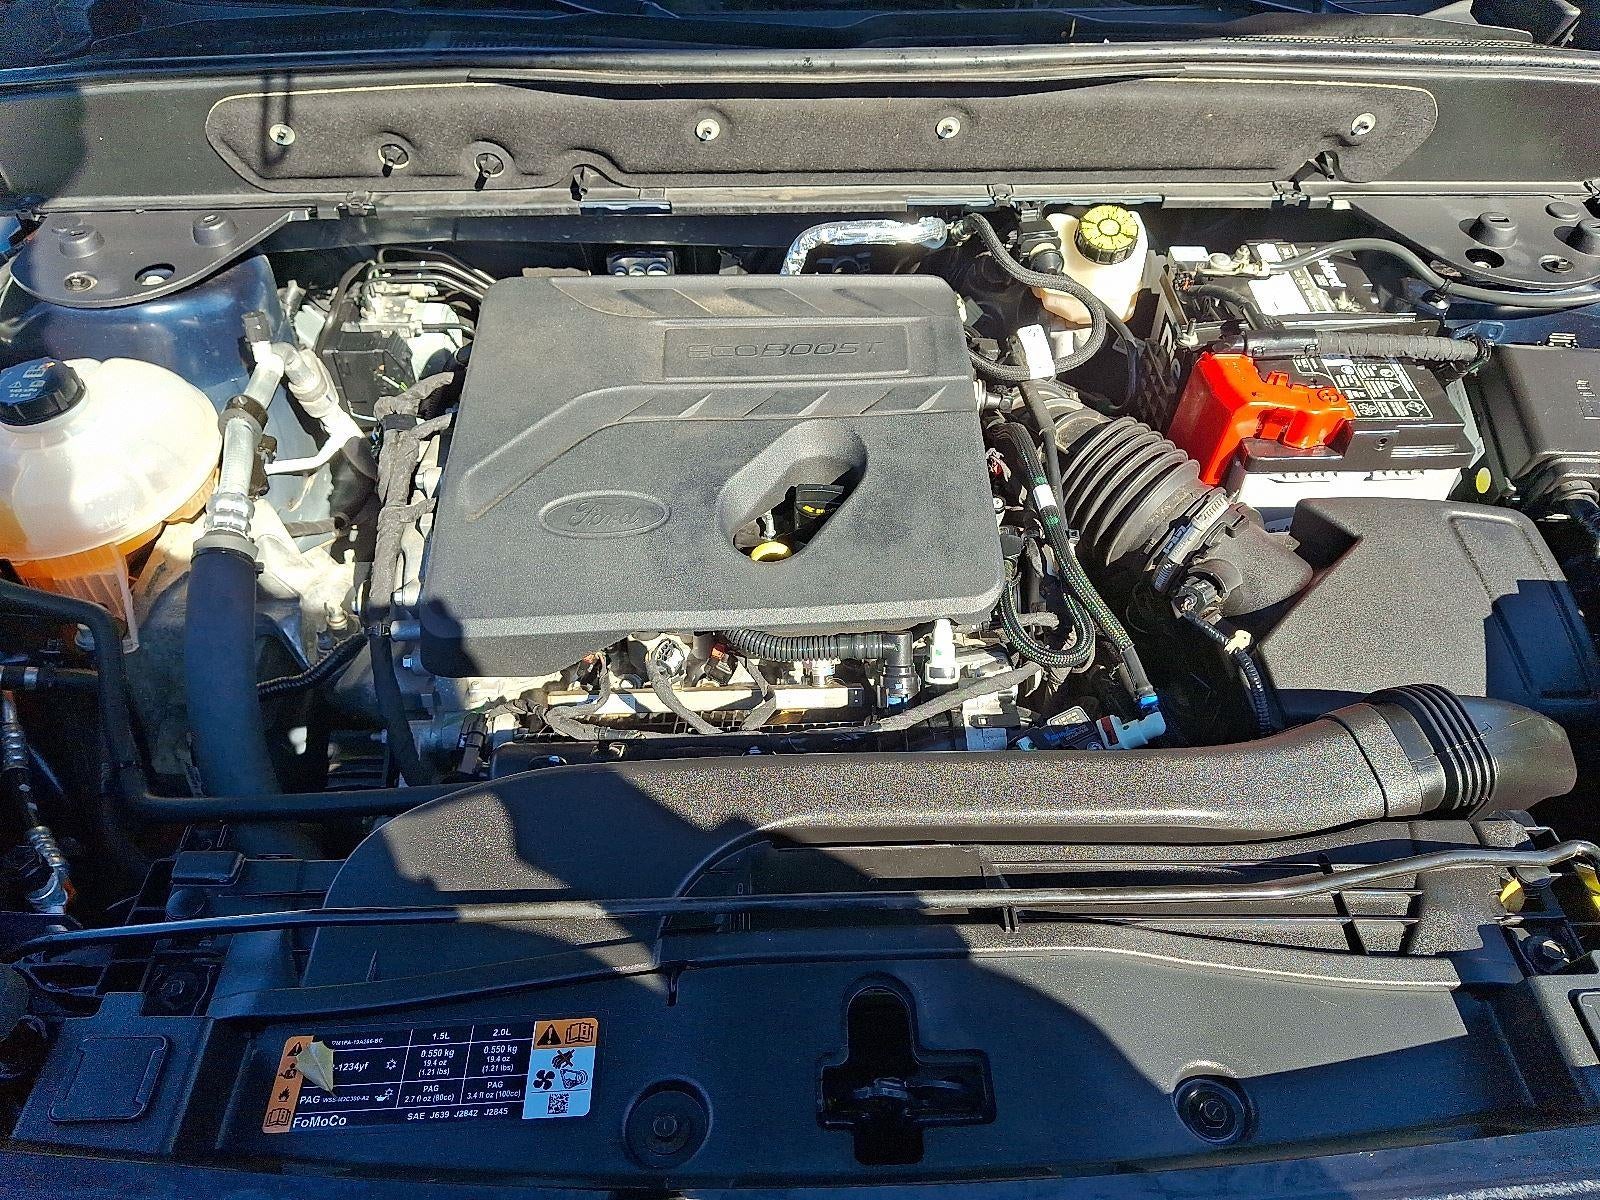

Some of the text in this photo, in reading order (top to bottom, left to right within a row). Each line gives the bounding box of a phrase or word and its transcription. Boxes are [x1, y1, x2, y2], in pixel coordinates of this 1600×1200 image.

[688, 341, 884, 359] ECOBOOST
[568, 501, 641, 527] Ford
[444, 1050, 454, 1058] kg
[507, 1045, 518, 1054] kg
[333, 1062, 369, 1072] -1234yf
[482, 1064, 513, 1073] (1.21 lbs)
[419, 1068, 449, 1077] (1.21 lbs)
[487, 1081, 503, 1089] PAG
[496, 1090, 521, 1099] (100cc)
[300, 1096, 320, 1104] PAG
[484, 1108, 508, 1116] J2845
[293, 1115, 346, 1128] FoMoCo
